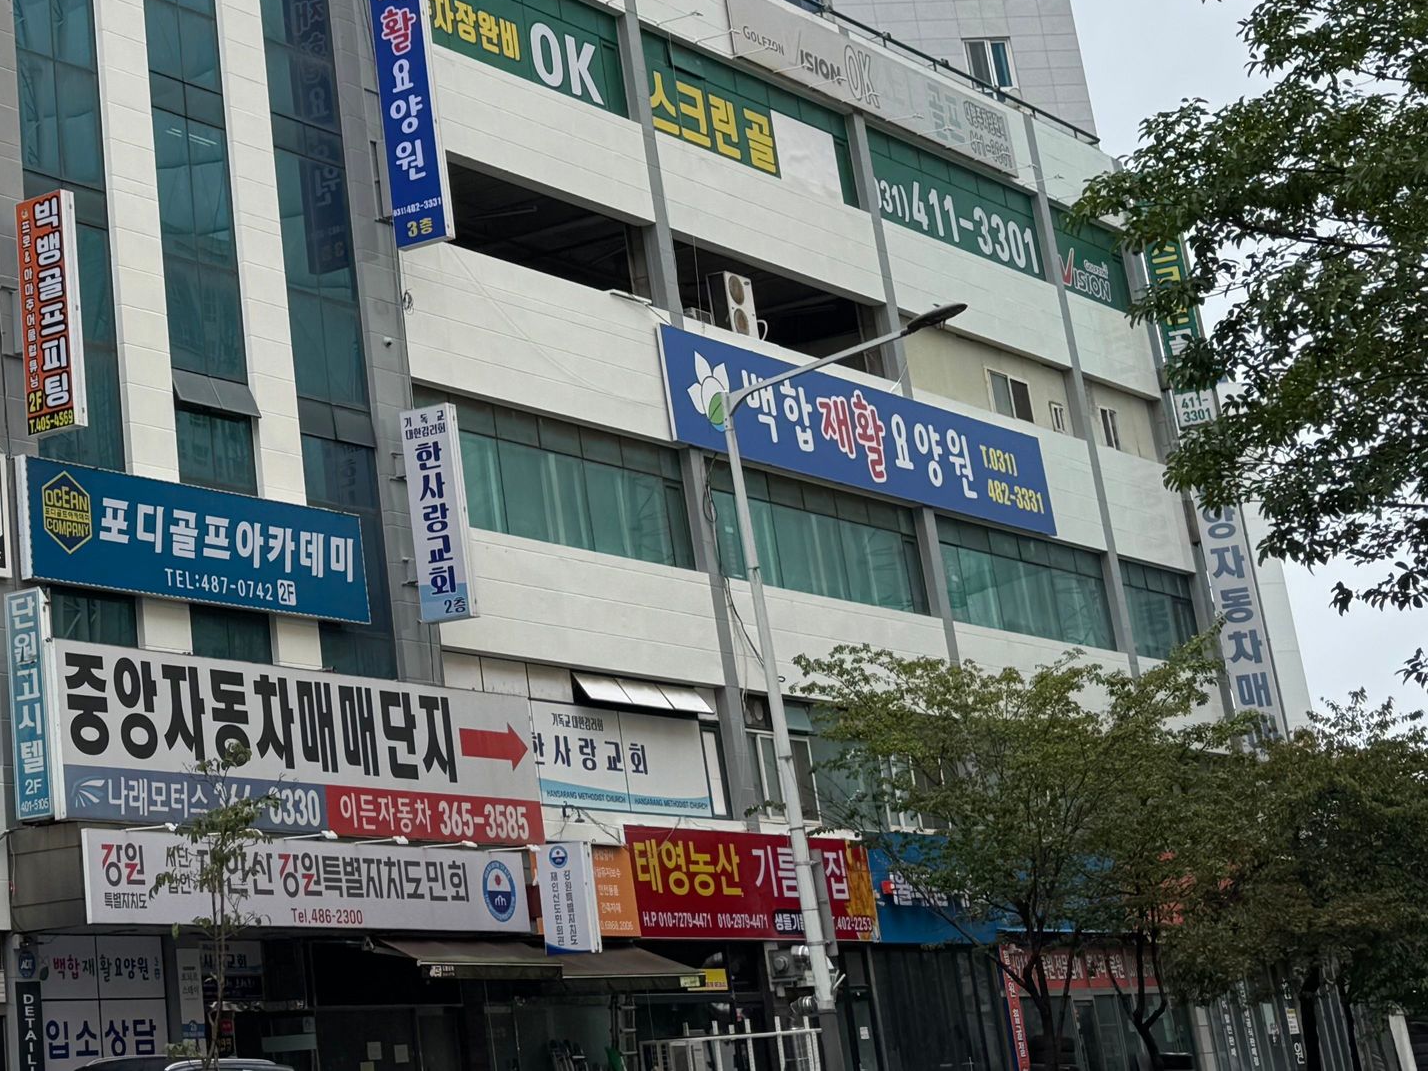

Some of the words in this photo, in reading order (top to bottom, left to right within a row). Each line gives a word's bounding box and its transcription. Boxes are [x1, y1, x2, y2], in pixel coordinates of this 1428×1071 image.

[529, 21, 606, 107] OK
[407, 217, 433, 238] 3층
[28, 390, 44, 414] 2F
[1182, 407, 1212, 423] 3301
[44, 485, 88, 512] OCEAN
[986, 480, 1046, 516] 482-3331
[46, 518, 90, 538] COMPANY
[414, 441, 458, 596] 한사랑교회
[99, 496, 355, 584] 포디골프아카데미
[278, 582, 296, 605] 2F
[443, 596, 467, 615] 2층
[11, 596, 45, 775] 단원고시텔
[65, 651, 459, 784] 중앙자동차매매단지
[24, 779, 43, 796] 2F
[106, 774, 210, 822] 나래모터스
[577, 791, 605, 802] METHODIST
[605, 793, 626, 804] CHURCH
[689, 800, 709, 811] CHURCH
[339, 792, 432, 832] 이든자동차
[438, 799, 530, 840] 365-3585
[100, 842, 147, 887] 강원
[278, 852, 471, 903] 강원특별자치도민회
[633, 838, 745, 898] 태영농산
[103, 890, 149, 910] 특별자치도
[775, 912, 806, 932] 생들기
